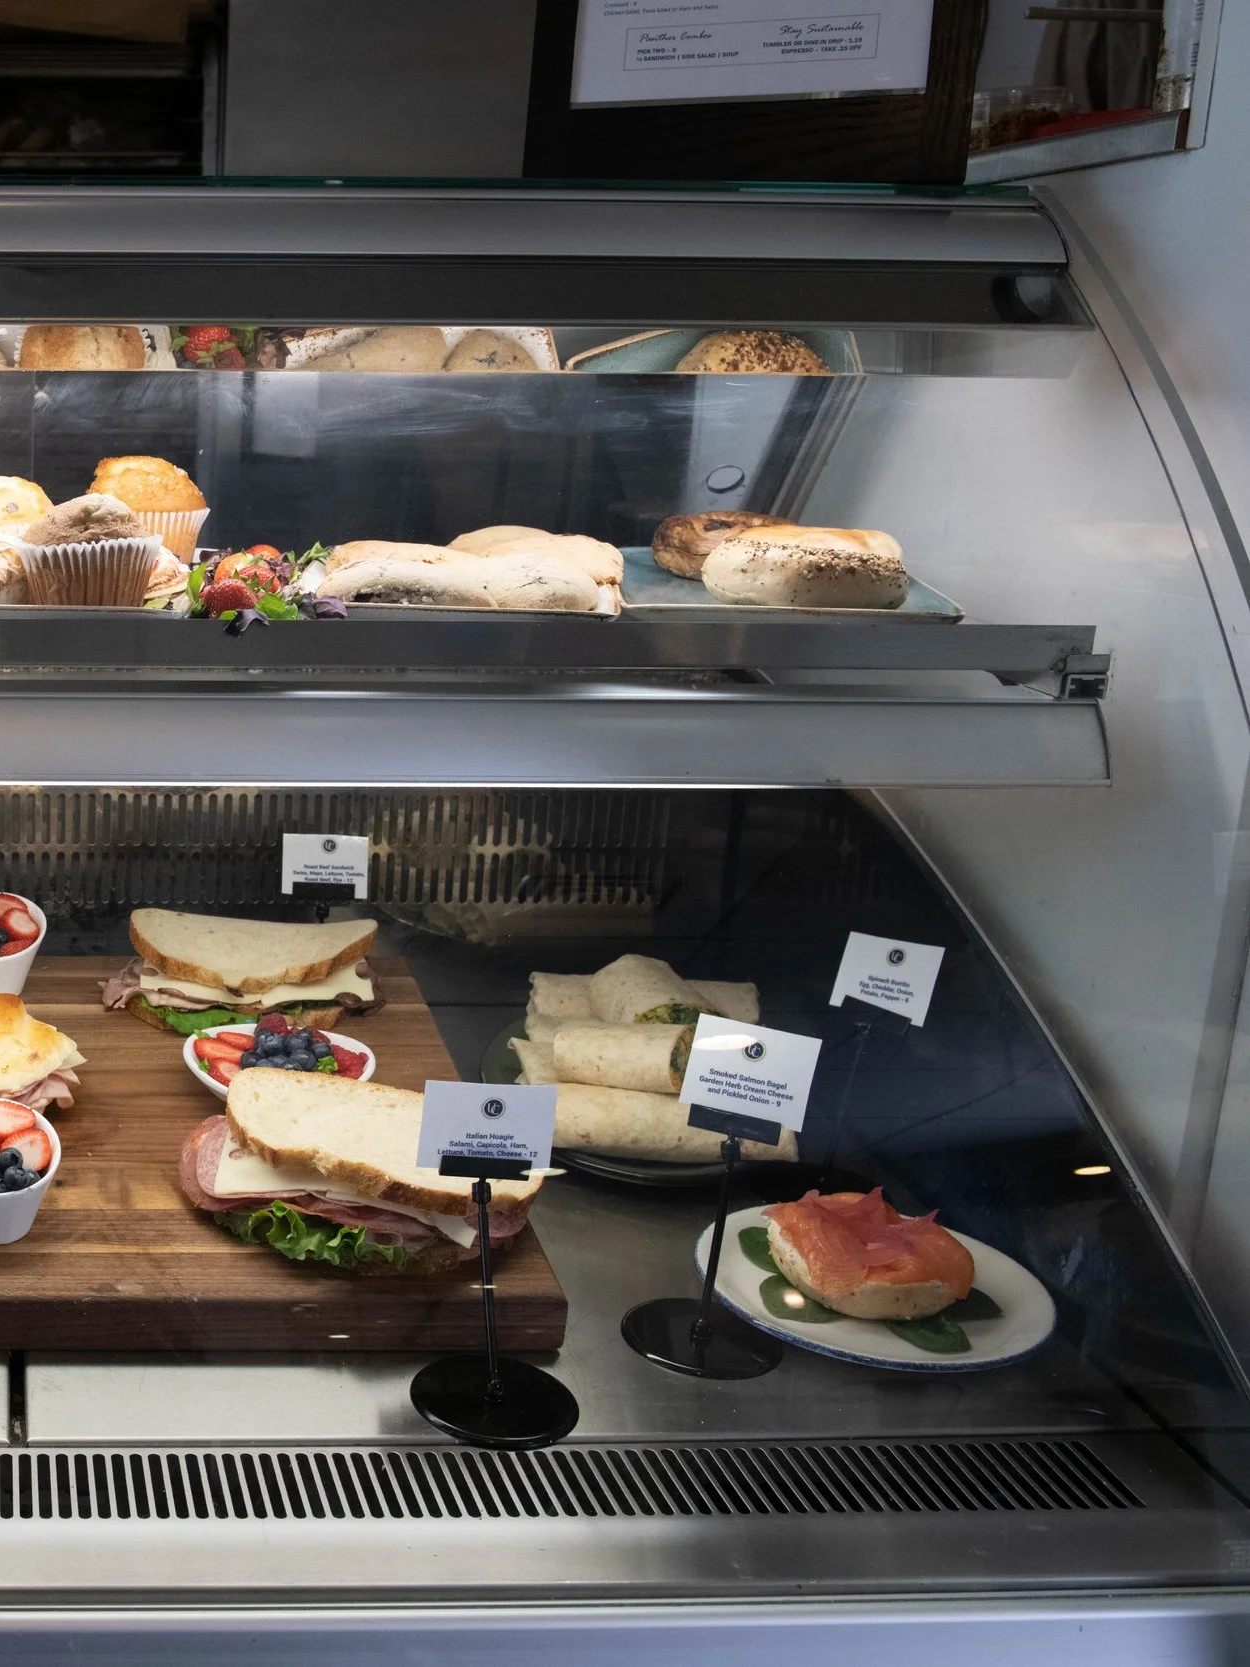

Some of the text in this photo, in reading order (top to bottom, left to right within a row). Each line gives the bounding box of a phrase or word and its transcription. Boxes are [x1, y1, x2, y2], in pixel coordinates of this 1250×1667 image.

[639, 30, 712, 43] Panther Combos
[780, 21, 864, 39] Stay Sustainable
[868, 975, 910, 988] Spinach Burrito
[860, 989, 880, 998] Potato,
[880, 993, 900, 1002] Pepper
[709, 1068, 787, 1090] Smoked Salmon Bagel
[699, 1075, 794, 1101] Garden Herb Cream Cheese
[721, 1089, 748, 1100] Pickled
[748, 1094, 770, 1105] Onion
[489, 1133, 514, 1142] Hoagie
[476, 1141, 508, 1150] Capicola,
[467, 1149, 495, 1158] Tomato,
